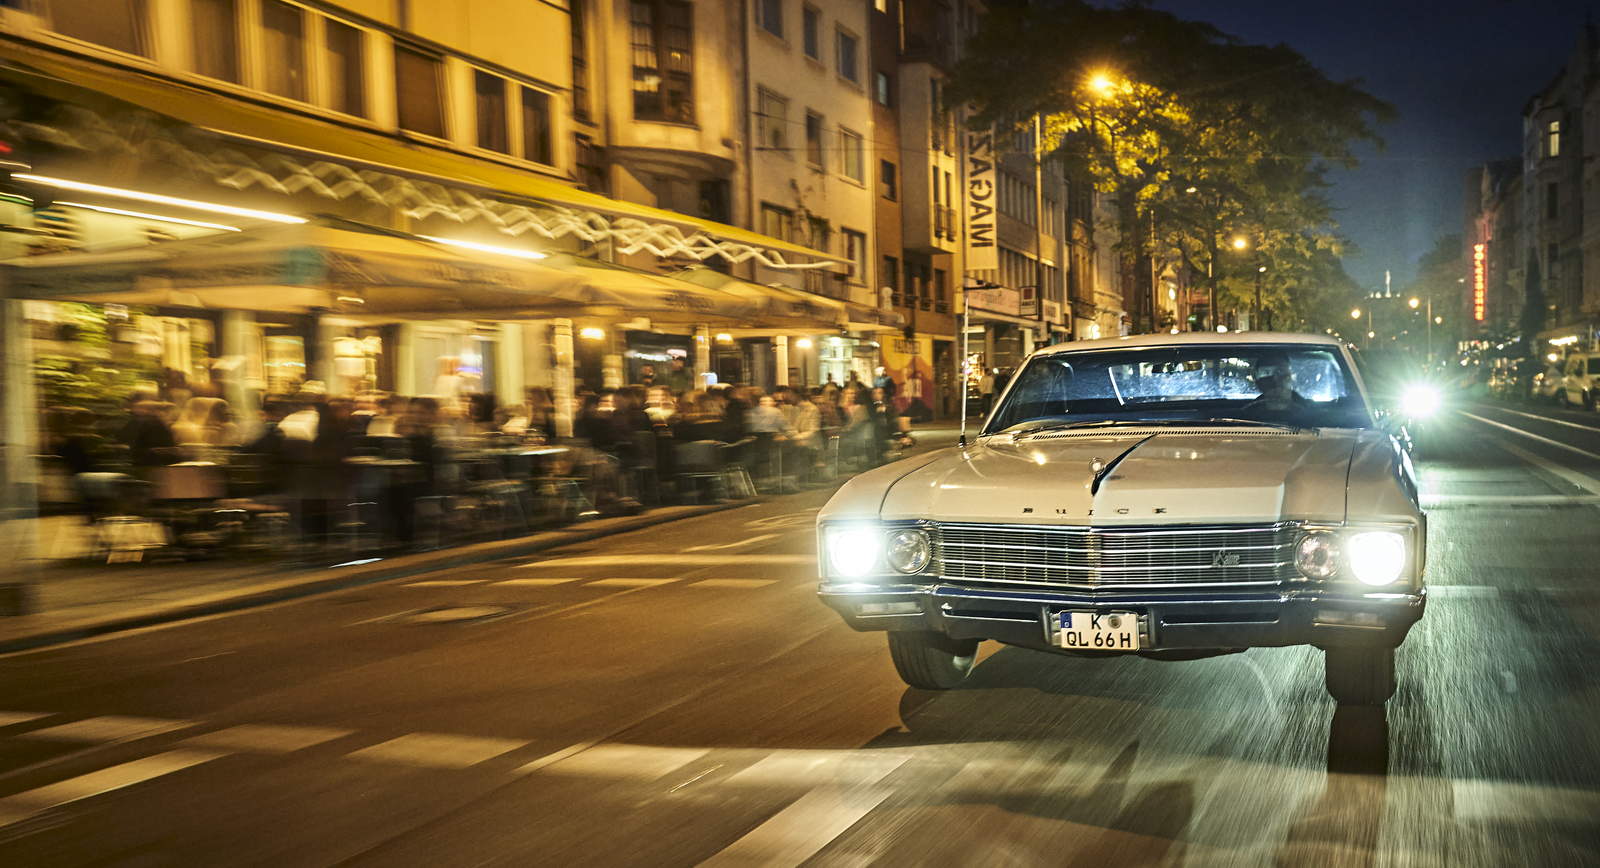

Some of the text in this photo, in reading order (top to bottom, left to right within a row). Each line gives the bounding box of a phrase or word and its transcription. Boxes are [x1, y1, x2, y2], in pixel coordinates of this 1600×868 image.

[1022, 507, 1168, 516] BUICK
[1091, 614, 1102, 630] K
[1066, 631, 1089, 647] QL
